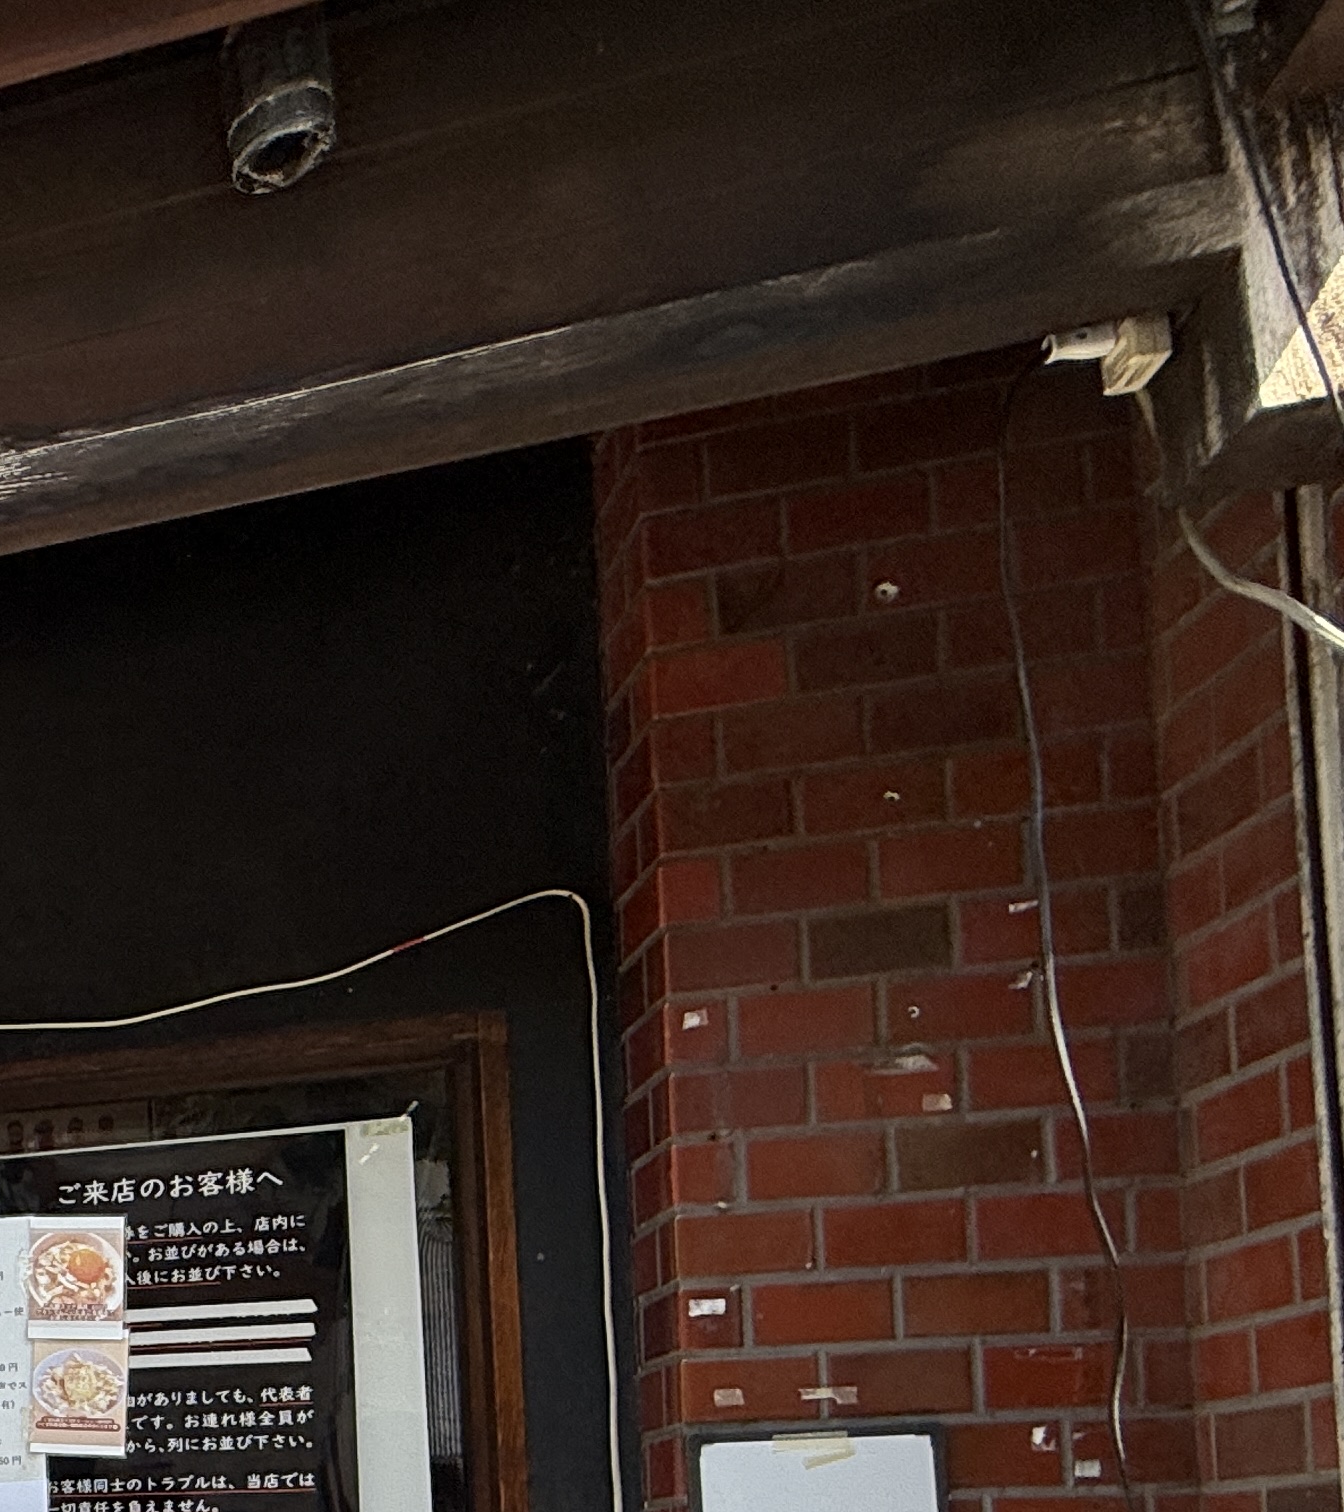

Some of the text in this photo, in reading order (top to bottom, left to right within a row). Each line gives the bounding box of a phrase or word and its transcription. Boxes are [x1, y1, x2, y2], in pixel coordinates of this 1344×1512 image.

[58, 1168, 283, 1205] ご来店のお客様へ
[127, 1410, 314, 1431] です。お連れ様全員が
